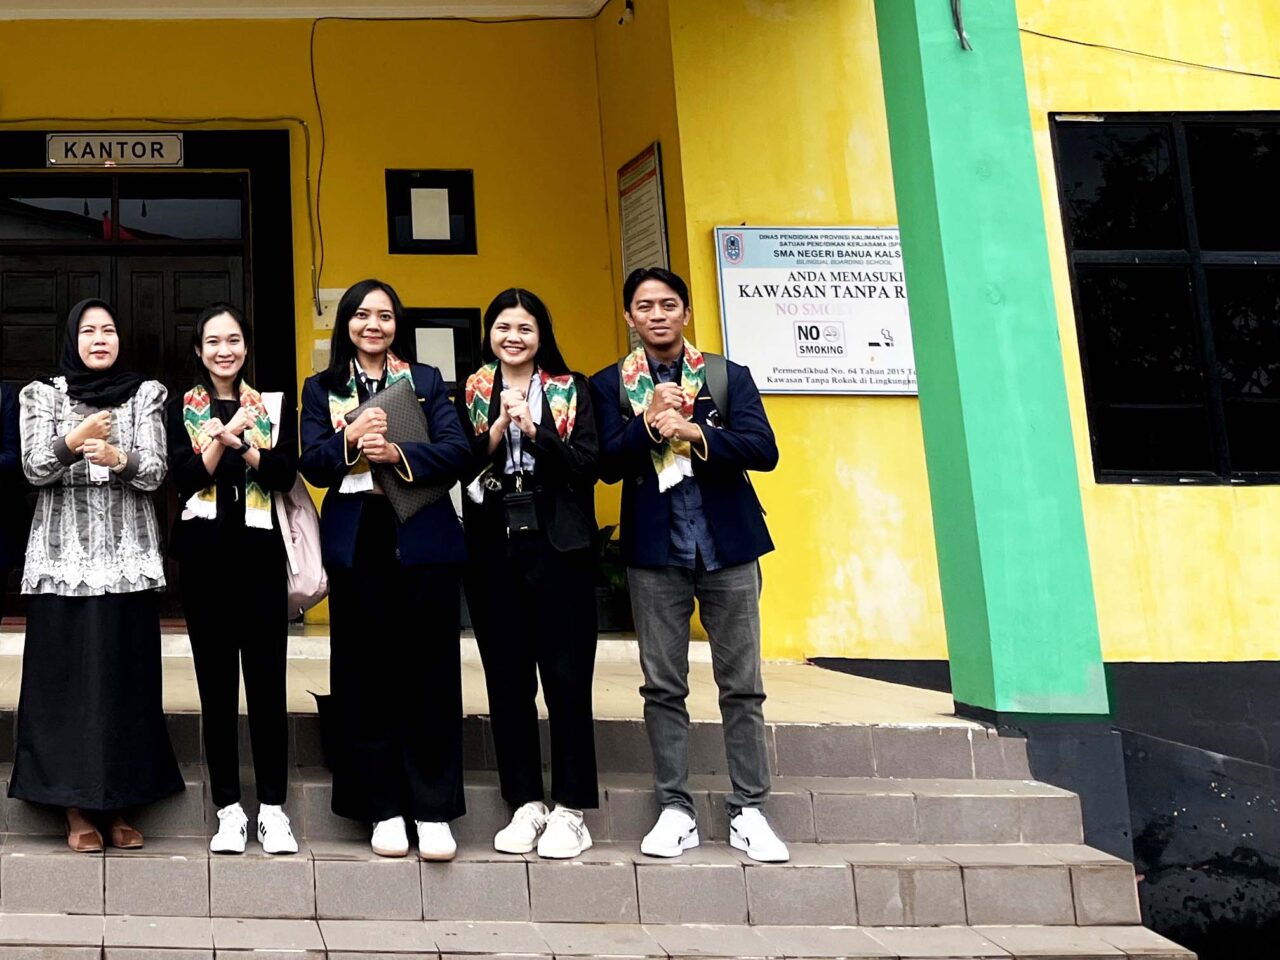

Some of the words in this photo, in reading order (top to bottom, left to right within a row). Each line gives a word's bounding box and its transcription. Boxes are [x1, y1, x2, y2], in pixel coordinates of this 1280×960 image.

[64, 141, 165, 159] KANTOR
[773, 250, 795, 258] SMA
[798, 250, 834, 258] NEGERI
[837, 250, 872, 258] BANUA
[875, 250, 901, 258] KALS
[787, 271, 827, 282] ANDA
[830, 271, 904, 282] MEMASUKI
[738, 284, 826, 298] KAWASAN
[831, 285, 890, 299] TANPA
[775, 303, 798, 316] NO
[797, 325, 820, 341] NO
[799, 345, 844, 354] SMOKING
